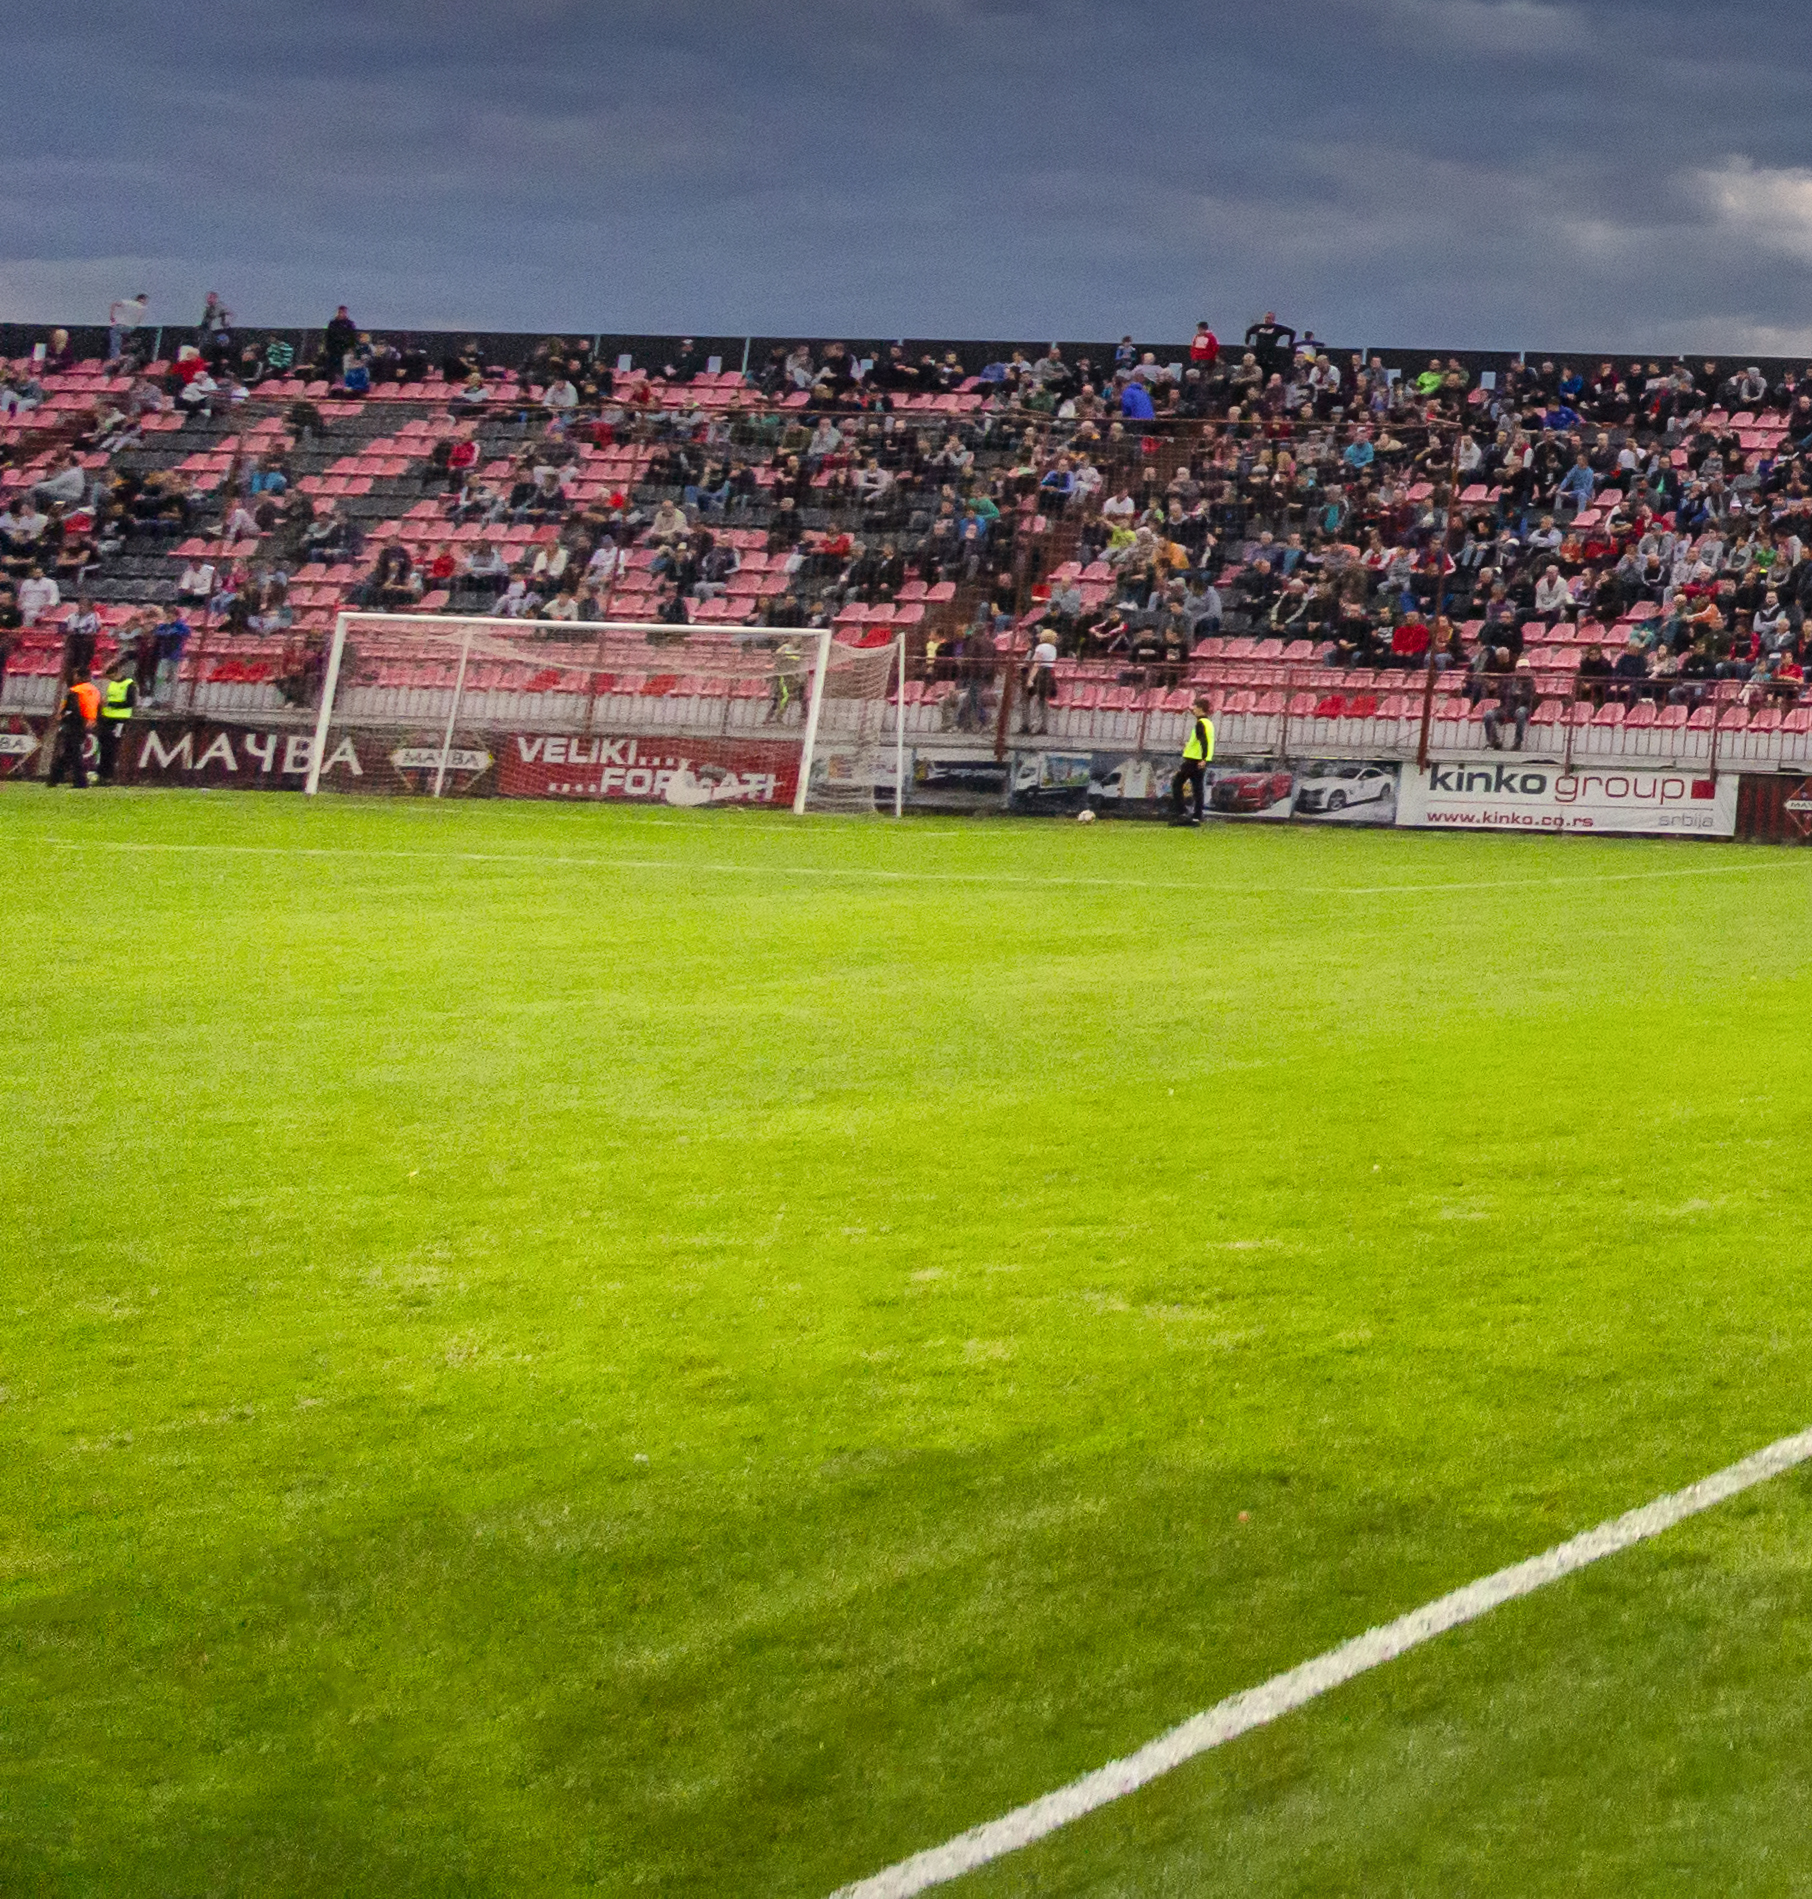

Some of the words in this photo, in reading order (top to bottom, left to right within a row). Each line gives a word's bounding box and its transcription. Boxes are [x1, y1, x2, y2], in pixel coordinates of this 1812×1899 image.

[138, 730, 363, 776] МАЧВА
[1429, 762, 1547, 794] kinko
[1554, 775, 1685, 805] group
[1426, 811, 1593, 827] www.kinko.co.rs
[1659, 813, 1714, 829] srbija
